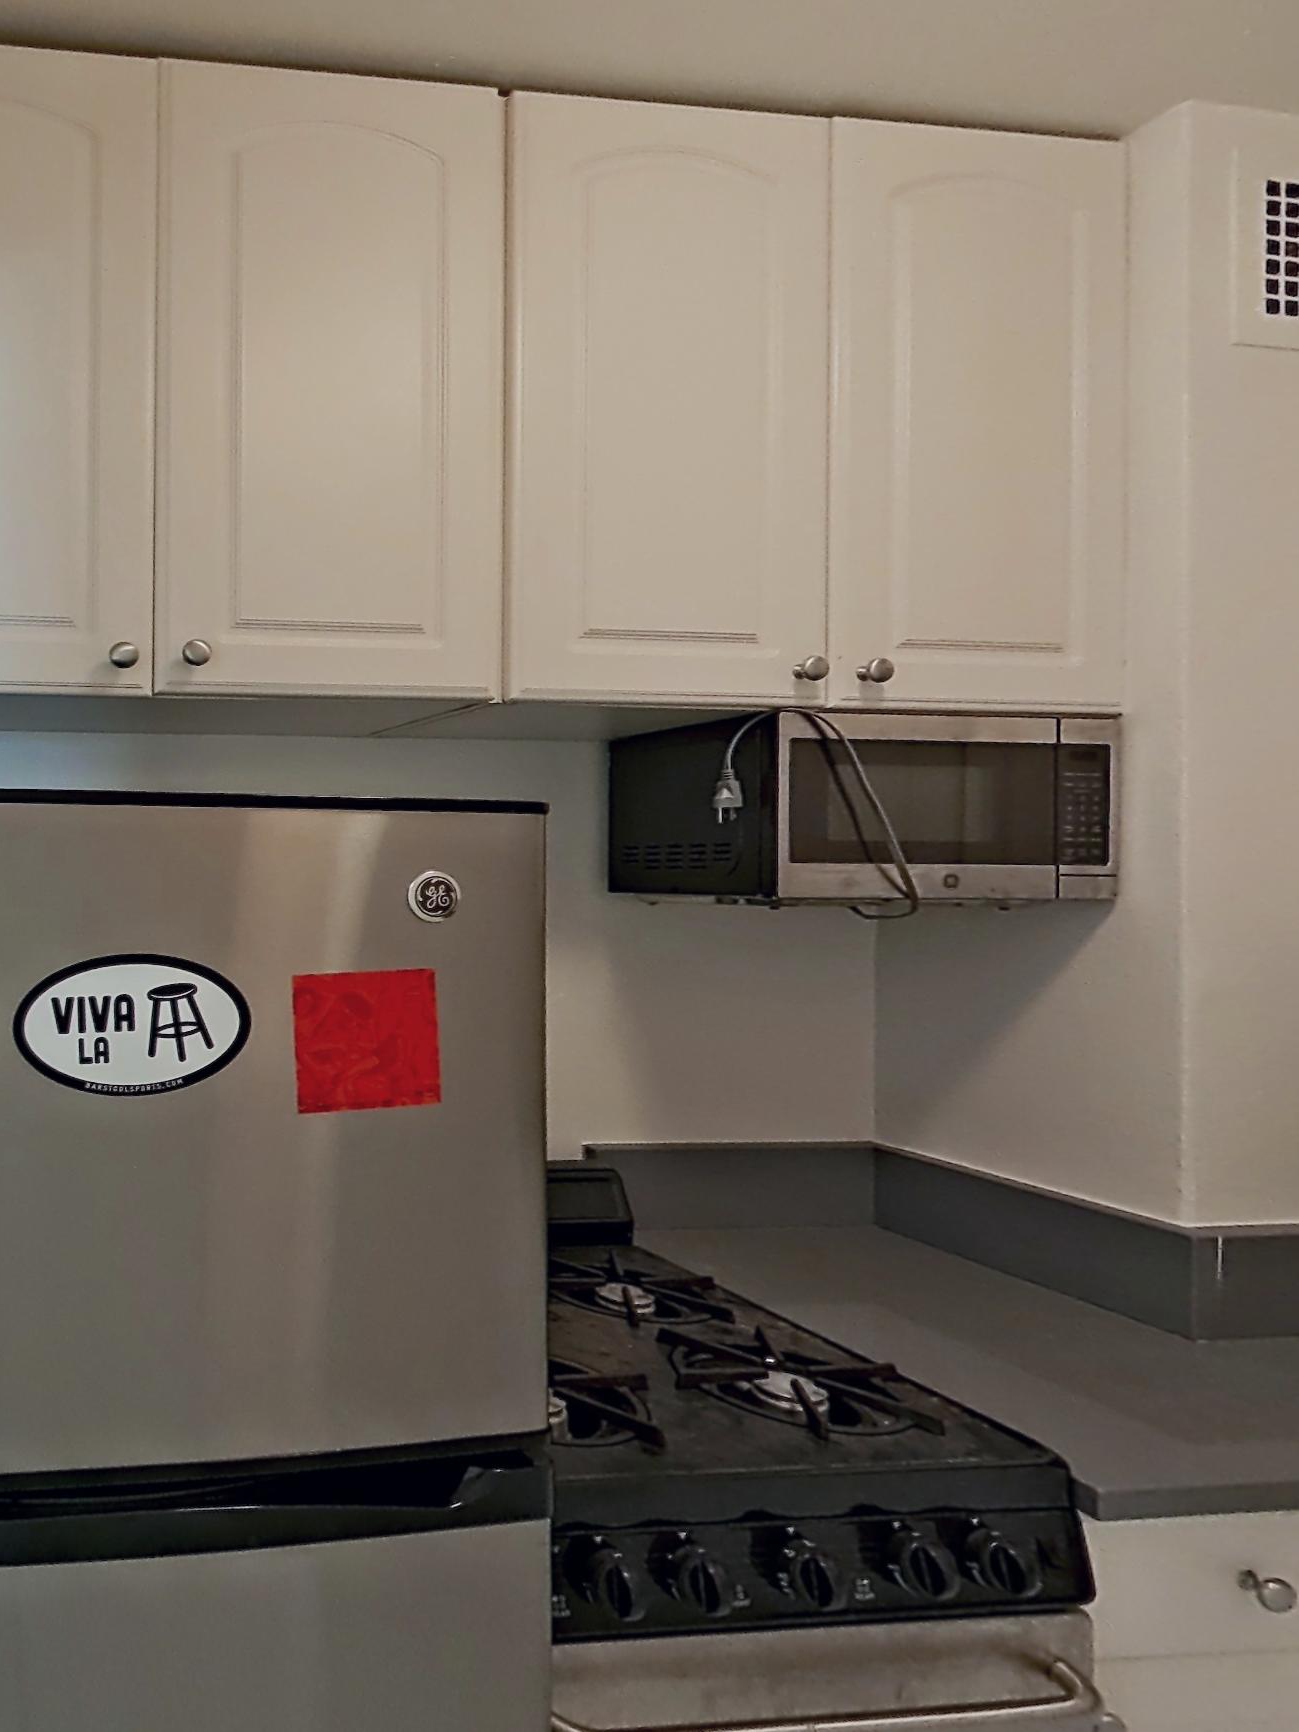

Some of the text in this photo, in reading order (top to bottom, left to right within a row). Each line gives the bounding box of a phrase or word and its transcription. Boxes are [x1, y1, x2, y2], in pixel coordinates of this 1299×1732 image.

[50, 993, 136, 1034] VIVA
[77, 1036, 110, 1065] LA
[83, 1078, 185, 1093] BARSTOOLSPORTS.COM
